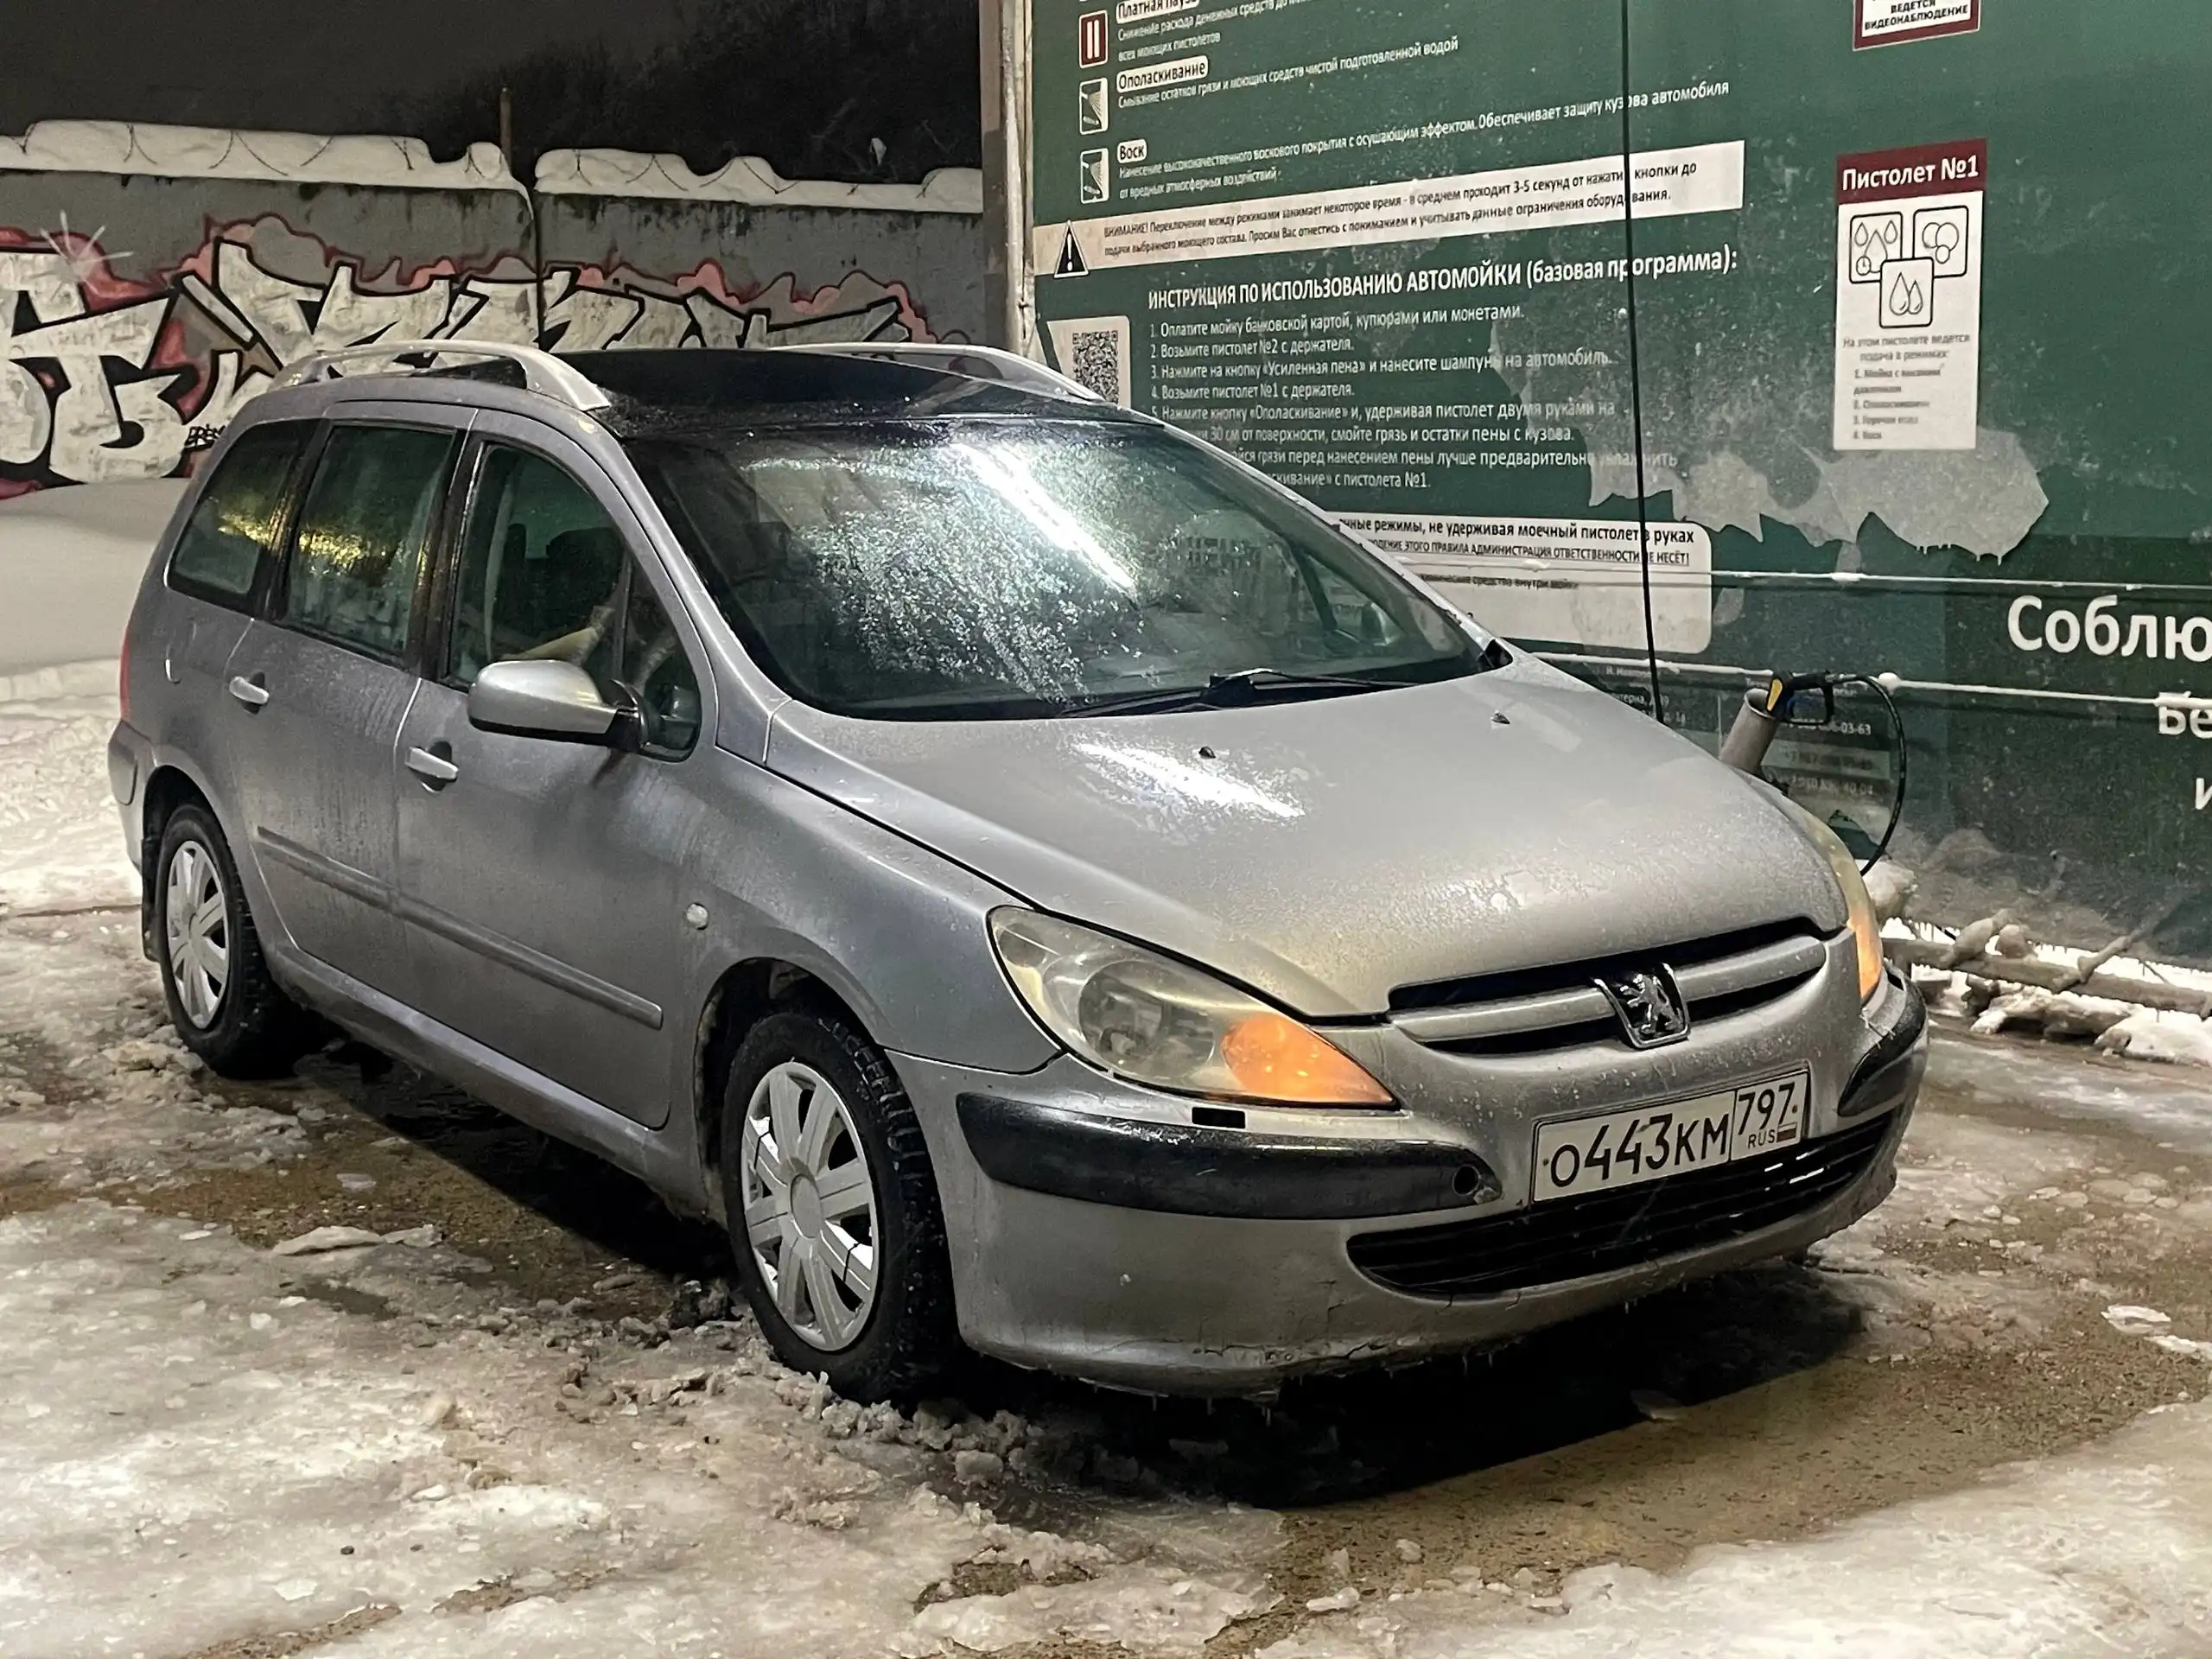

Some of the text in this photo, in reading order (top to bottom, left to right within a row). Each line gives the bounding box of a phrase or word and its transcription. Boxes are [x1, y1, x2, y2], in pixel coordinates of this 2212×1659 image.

[1118, 1, 1163, 19] Платная
[1865, 4, 1968, 30] ВИДЕОНАБЛЮДЕНИЕ
[1891, 0, 1936, 14] ВЕДЕТСЯ
[1119, 61, 1205, 89] Ополаскивание
[1160, 86, 1196, 100] остатков
[1223, 79, 1229, 90] и
[1268, 67, 1304, 84] средств
[1306, 56, 1338, 74] чистой
[1340, 42, 1421, 70] подготовленной
[1424, 35, 1458, 56] водой
[1254, 142, 1300, 161] воскового
[1301, 137, 1346, 155] покрытия
[1349, 137, 1354, 148] с
[1357, 127, 1418, 148] осушающим
[1478, 106, 1560, 129] Обеспечивает
[1563, 99, 1603, 118] защиту
[1651, 81, 1729, 105] автомобиля
[1120, 144, 1145, 161] Воск
[1842, 155, 1979, 191] Пистолет №1
[1104, 221, 1148, 238] ВНИМАНИЕ!
[1150, 218, 1206, 233] Переключение
[1236, 209, 1280, 226] режимами
[1282, 205, 1322, 219] занимает
[1324, 200, 1370, 214] некоторое
[1372, 196, 1402, 210] время
[1417, 189, 1460, 206] среднем
[1463, 185, 1510, 200] проходит
[1514, 180, 1529, 194] 3-5
[1533, 176, 1569, 192] секунд
[1573, 175, 1583, 187] от
[1586, 170, 1626, 185] нажати
[1635, 164, 1678, 179] кнопки
[1681, 162, 1697, 178] до
[1132, 240, 1176, 255] выбранного
[1282, 227, 1296, 239] Вас
[1298, 223, 1340, 238] отнестись
[1342, 223, 1347, 232] с
[1349, 216, 1408, 232] пониманием
[1411, 215, 1417, 226] и
[1472, 206, 1513, 222] данные
[1516, 198, 1584, 217] ограничения
[1586, 189, 1671, 208] оборудвания.
[1148, 285, 1236, 309] ИНСТРУКЦИЯ
[1239, 283, 1258, 302] ПО
[1262, 272, 1402, 302] ИСПОЛЬЗОВАНИЮ
[1407, 259, 1521, 292] АВТОМОЙКИ
[1527, 258, 1604, 289] (базовая
[1160, 321, 1208, 337] Оплатите
[1211, 318, 1243, 337] мойку
[1245, 315, 1307, 334] банковской
[1311, 311, 1353, 333] картой,
[1357, 311, 1420, 331] купюрами
[1423, 309, 1447, 323] или
[1451, 304, 1524, 321] монетами.
[1160, 343, 1209, 358] Возьмите
[1211, 341, 1257, 356] пистолет
[1259, 338, 1278, 353] №2
[1281, 341, 1287, 353] с
[1290, 338, 1355, 356] держателя.
[1161, 364, 1207, 378] Нажмите
[1210, 365, 1223, 377] на
[1225, 364, 1261, 378] кнопку
[1331, 359, 1365, 374] пена»
[1370, 360, 1376, 372] и
[1380, 357, 1437, 372] нанесите
[1506, 355, 1522, 368] на
[1161, 385, 1210, 399] Возьмите
[1212, 385, 1258, 398] пистолет
[1260, 382, 1278, 398] №1
[1282, 385, 1288, 397] с
[1290, 382, 1355, 400] держателя.
[1162, 401, 1615, 423] Нажмите кнопку «Ополаскивание» и, удерживая пистолет двумя руками на
[1242, 429, 1253, 442] от
[1255, 428, 1328, 444] поверхности,
[1332, 425, 1372, 442] смойте
[1376, 429, 1407, 445] грязь
[1411, 429, 1418, 442] и
[1421, 429, 1469, 442] остатки
[1472, 428, 1510, 442] пены
[1514, 429, 1521, 442] с
[1525, 427, 1574, 445] кузова.
[1257, 451, 1286, 465] грязи
[1288, 450, 1325, 465] перед
[1327, 449, 1397, 466] нанесением
[1401, 452, 1433, 465] пены
[1436, 451, 1476, 468] лучше
[1335, 472, 1431, 488] с пистолета №1.
[1375, 519, 1426, 535] режимы,
[1429, 521, 1443, 533] не
[1446, 521, 1513, 537] удерживая
[1518, 522, 1578, 538] моечный
[1581, 526, 1639, 541] пистолет
[1654, 530, 1694, 545] руках
[1403, 539, 1429, 552] ЭТОГО
[1431, 541, 1469, 553] ПРАВИЛА
[1471, 543, 1552, 558] АДМИНИСТРАЦИЯ
[1554, 547, 1640, 562] ОТВЕТСТВЕННОСТИ
[1656, 551, 1689, 563] НЕСЁТ!
[1550, 1083, 1796, 1188] О443КМ 797
[1748, 1128, 1776, 1150] RUS
